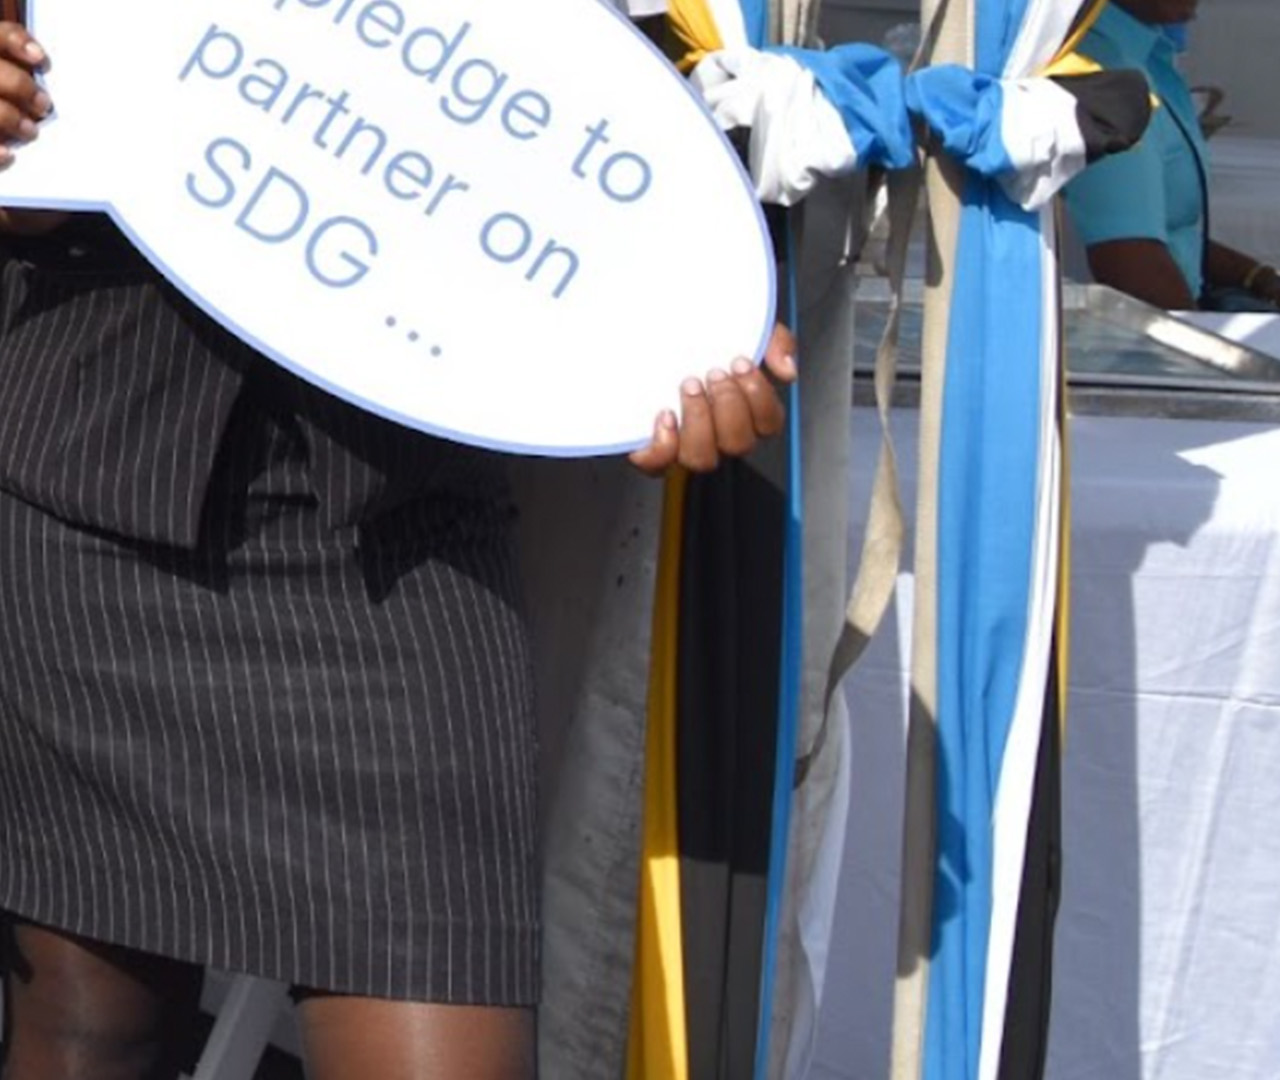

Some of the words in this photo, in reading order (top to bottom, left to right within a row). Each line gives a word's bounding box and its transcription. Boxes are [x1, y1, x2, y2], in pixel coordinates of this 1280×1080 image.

[179, 22, 467, 215] partner
[479, 210, 580, 300] on
[185, 136, 380, 288] SDG
[569, 119, 652, 203] to
